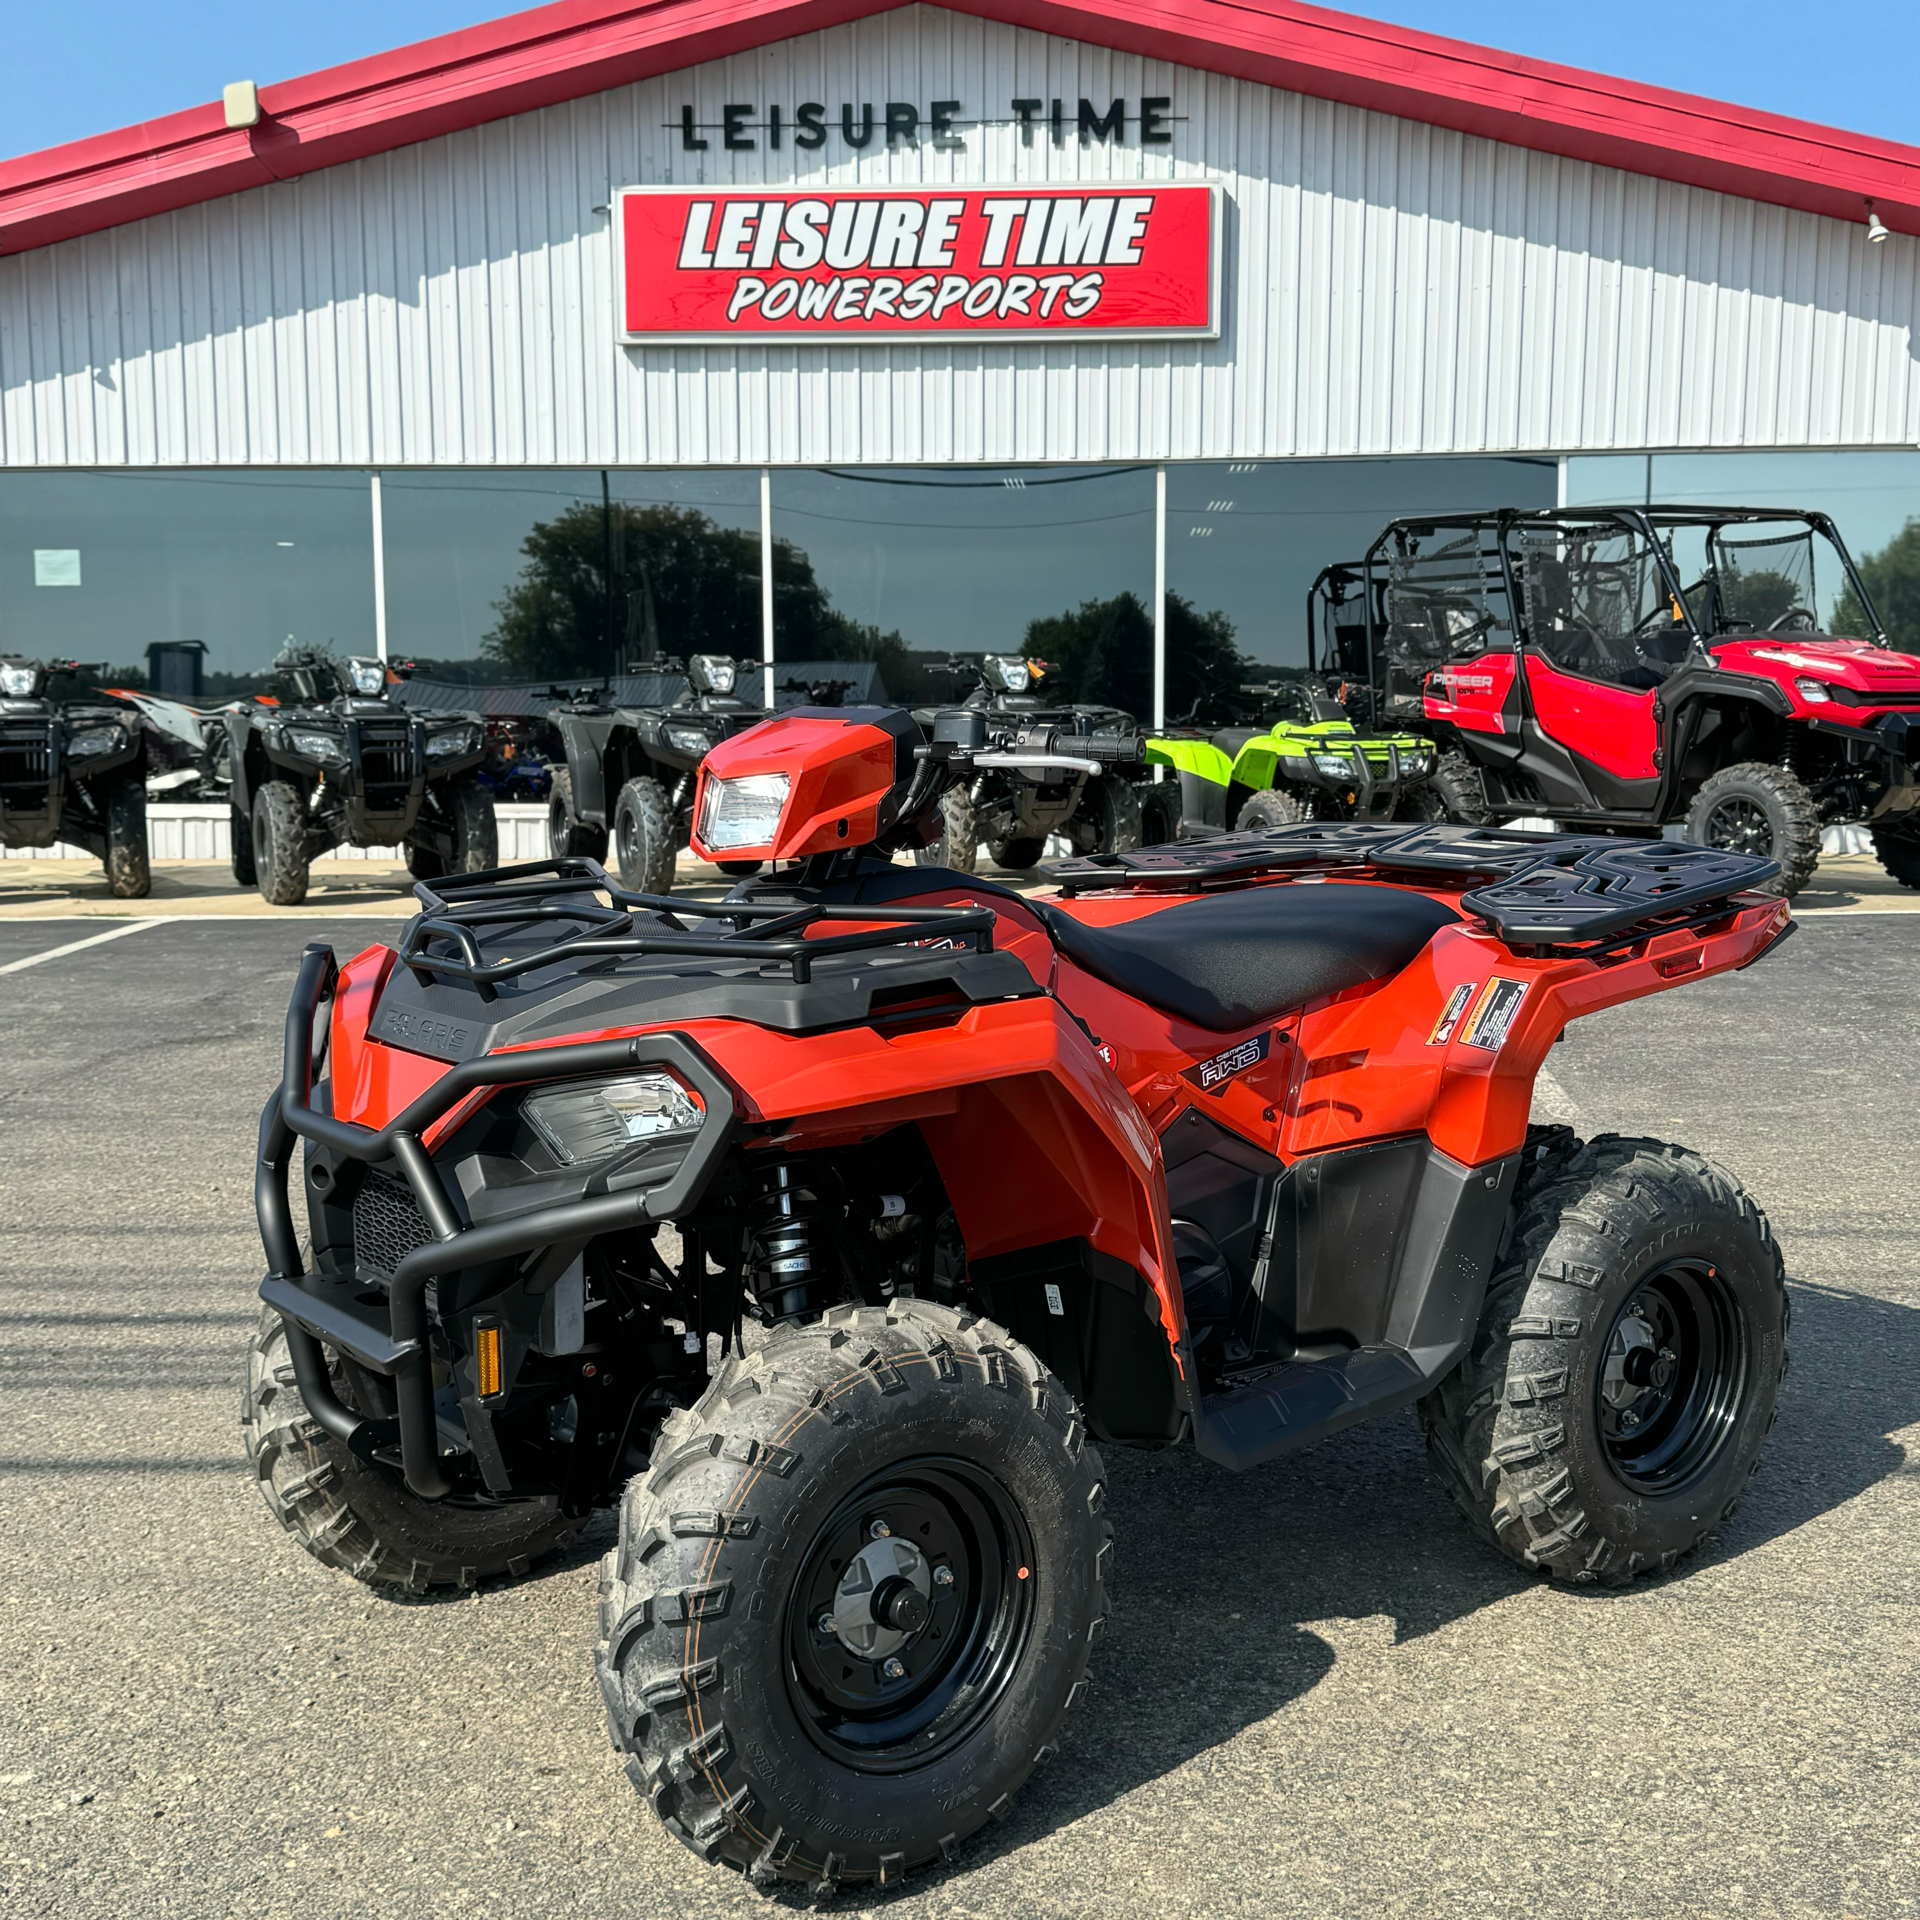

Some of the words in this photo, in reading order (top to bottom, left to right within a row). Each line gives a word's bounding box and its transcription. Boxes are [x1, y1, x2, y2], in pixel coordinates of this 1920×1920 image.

[681, 99, 963, 151] LEISURE
[1011, 96, 1173, 148] TIME
[677, 198, 966, 270] LEISURE
[979, 195, 1155, 267] TIME
[727, 273, 1104, 322] POWERSPORTS
[1433, 673, 1493, 687] PIONEER
[381, 1009, 469, 1053] POLARIS
[1216, 1038, 1259, 1063] DEMAND
[1201, 1046, 1260, 1087] AWD
[783, 1261, 806, 1269] SACHS
